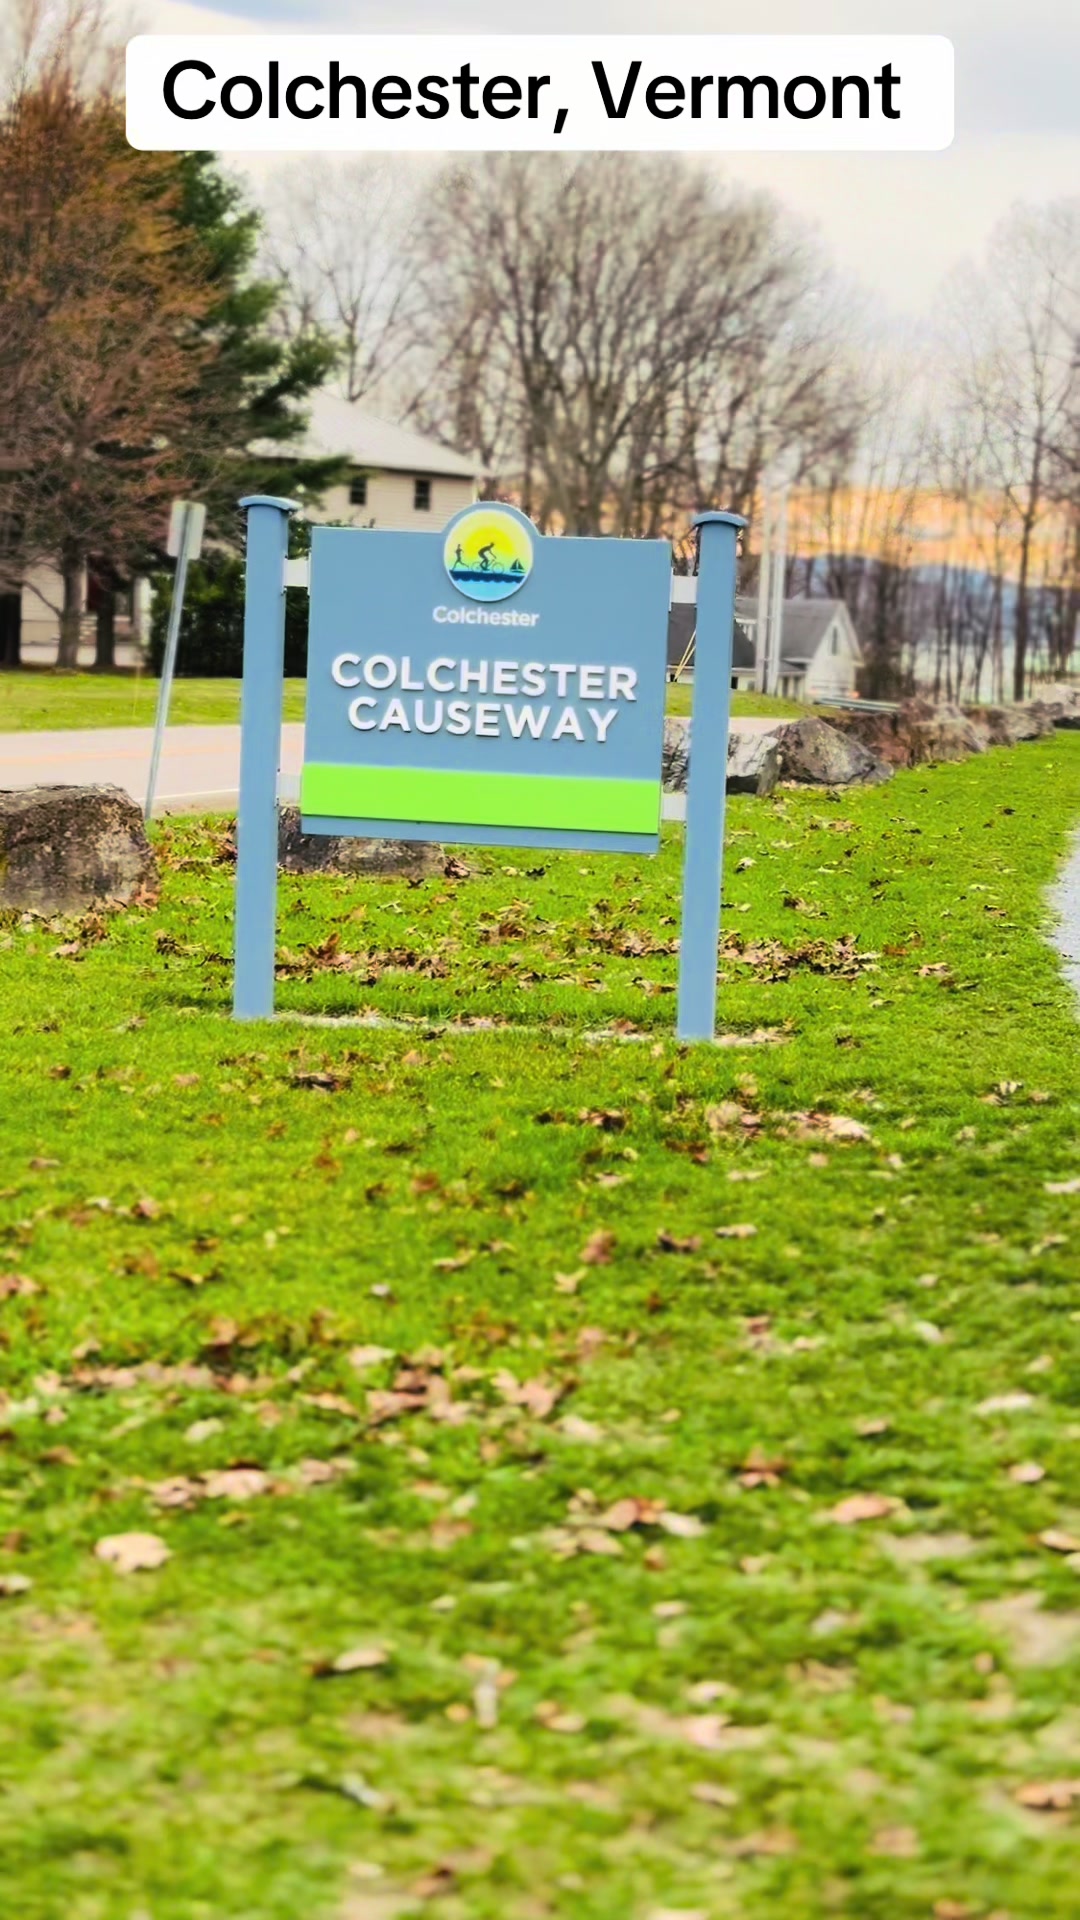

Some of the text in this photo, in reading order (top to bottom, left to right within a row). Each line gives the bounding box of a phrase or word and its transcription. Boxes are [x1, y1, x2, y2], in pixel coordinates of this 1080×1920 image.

[432, 605, 540, 627] Colchester
[331, 652, 638, 701] COLCHESTER
[348, 696, 618, 742] CAUSEWAY
